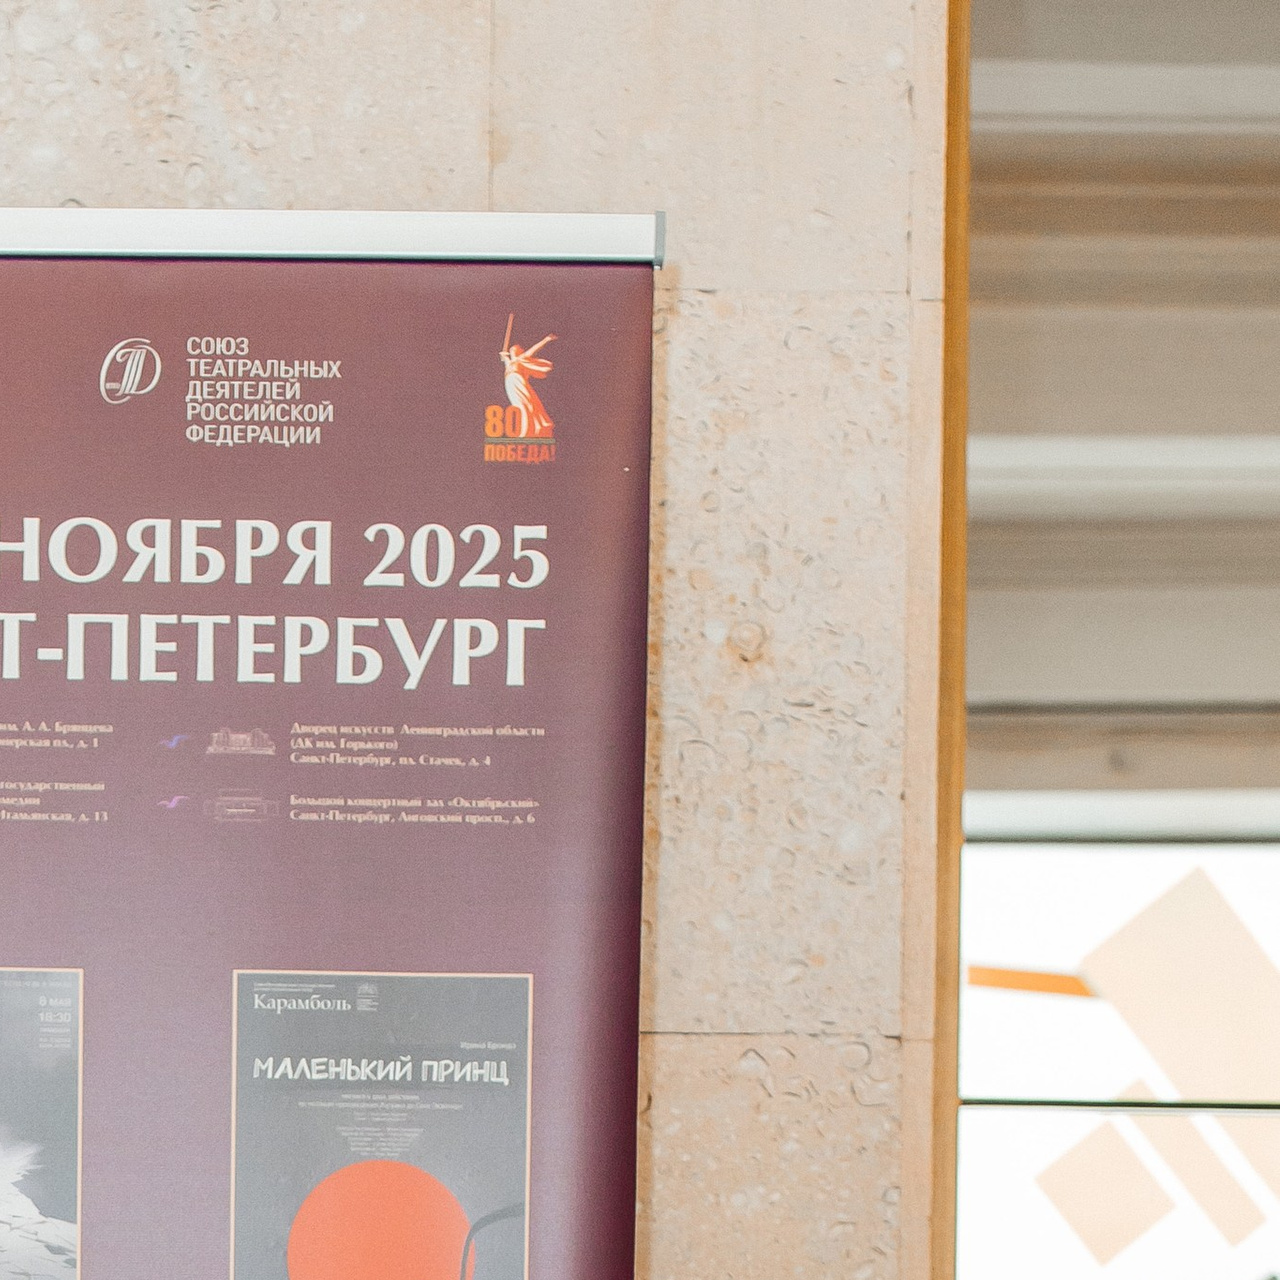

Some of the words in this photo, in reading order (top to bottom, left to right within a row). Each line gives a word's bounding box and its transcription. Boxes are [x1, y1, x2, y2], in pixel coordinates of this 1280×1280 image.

[187, 337, 249, 355] СОЮЗ
[187, 359, 341, 380] ТЕАТРАЛЬНЫХ
[186, 378, 300, 401] ДЕЯТЕЛЕЙ
[186, 399, 333, 422] РОССИЙСКОЙ
[186, 425, 320, 447] ФЕДЕРАЦИИ
[484, 444, 555, 463] ПОБЕДА!
[364, 523, 549, 588] 2025
